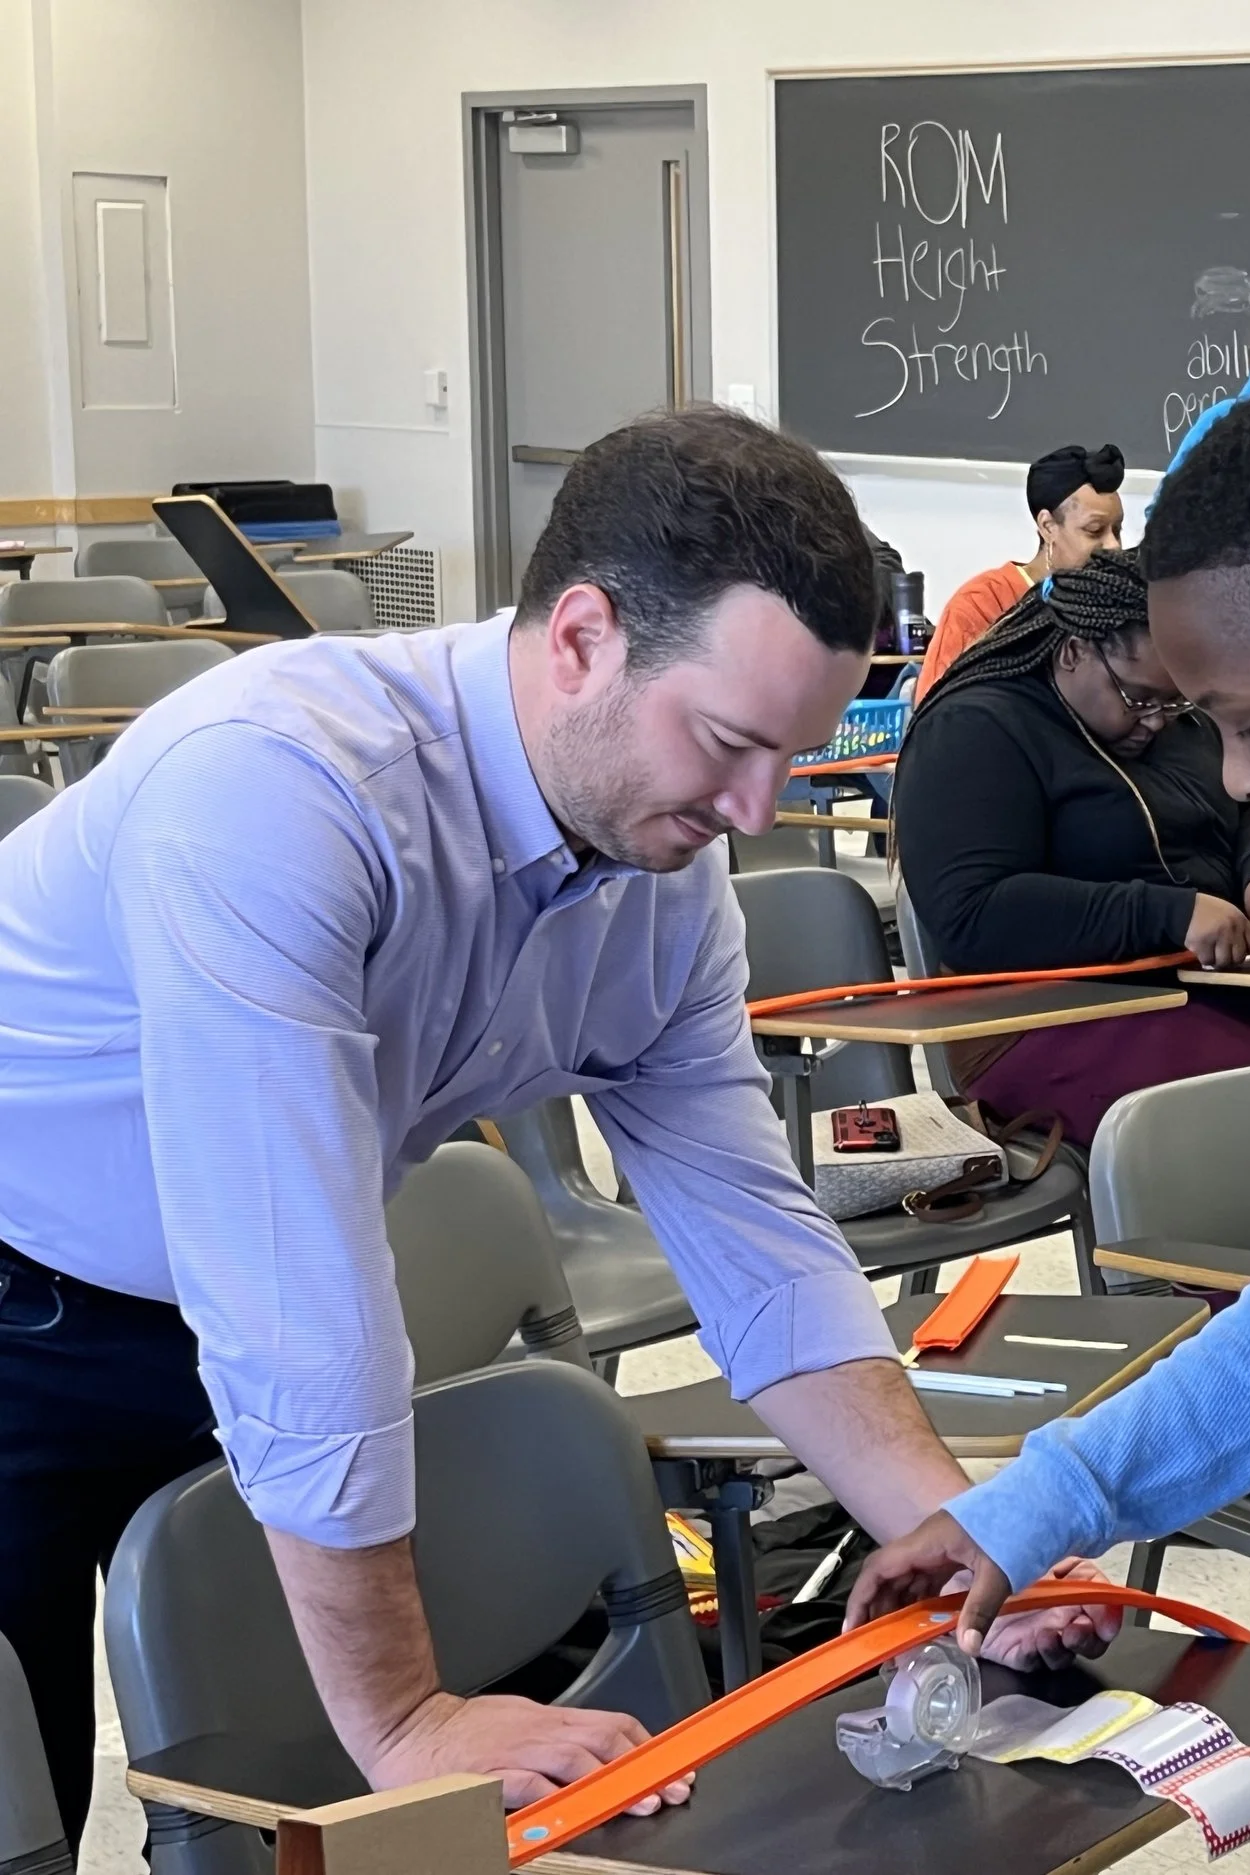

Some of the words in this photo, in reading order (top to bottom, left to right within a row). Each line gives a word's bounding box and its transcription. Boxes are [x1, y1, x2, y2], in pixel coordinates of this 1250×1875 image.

[881, 120, 1008, 228] ROM
[873, 222, 1007, 332] Height
[855, 317, 1048, 420] Strength
